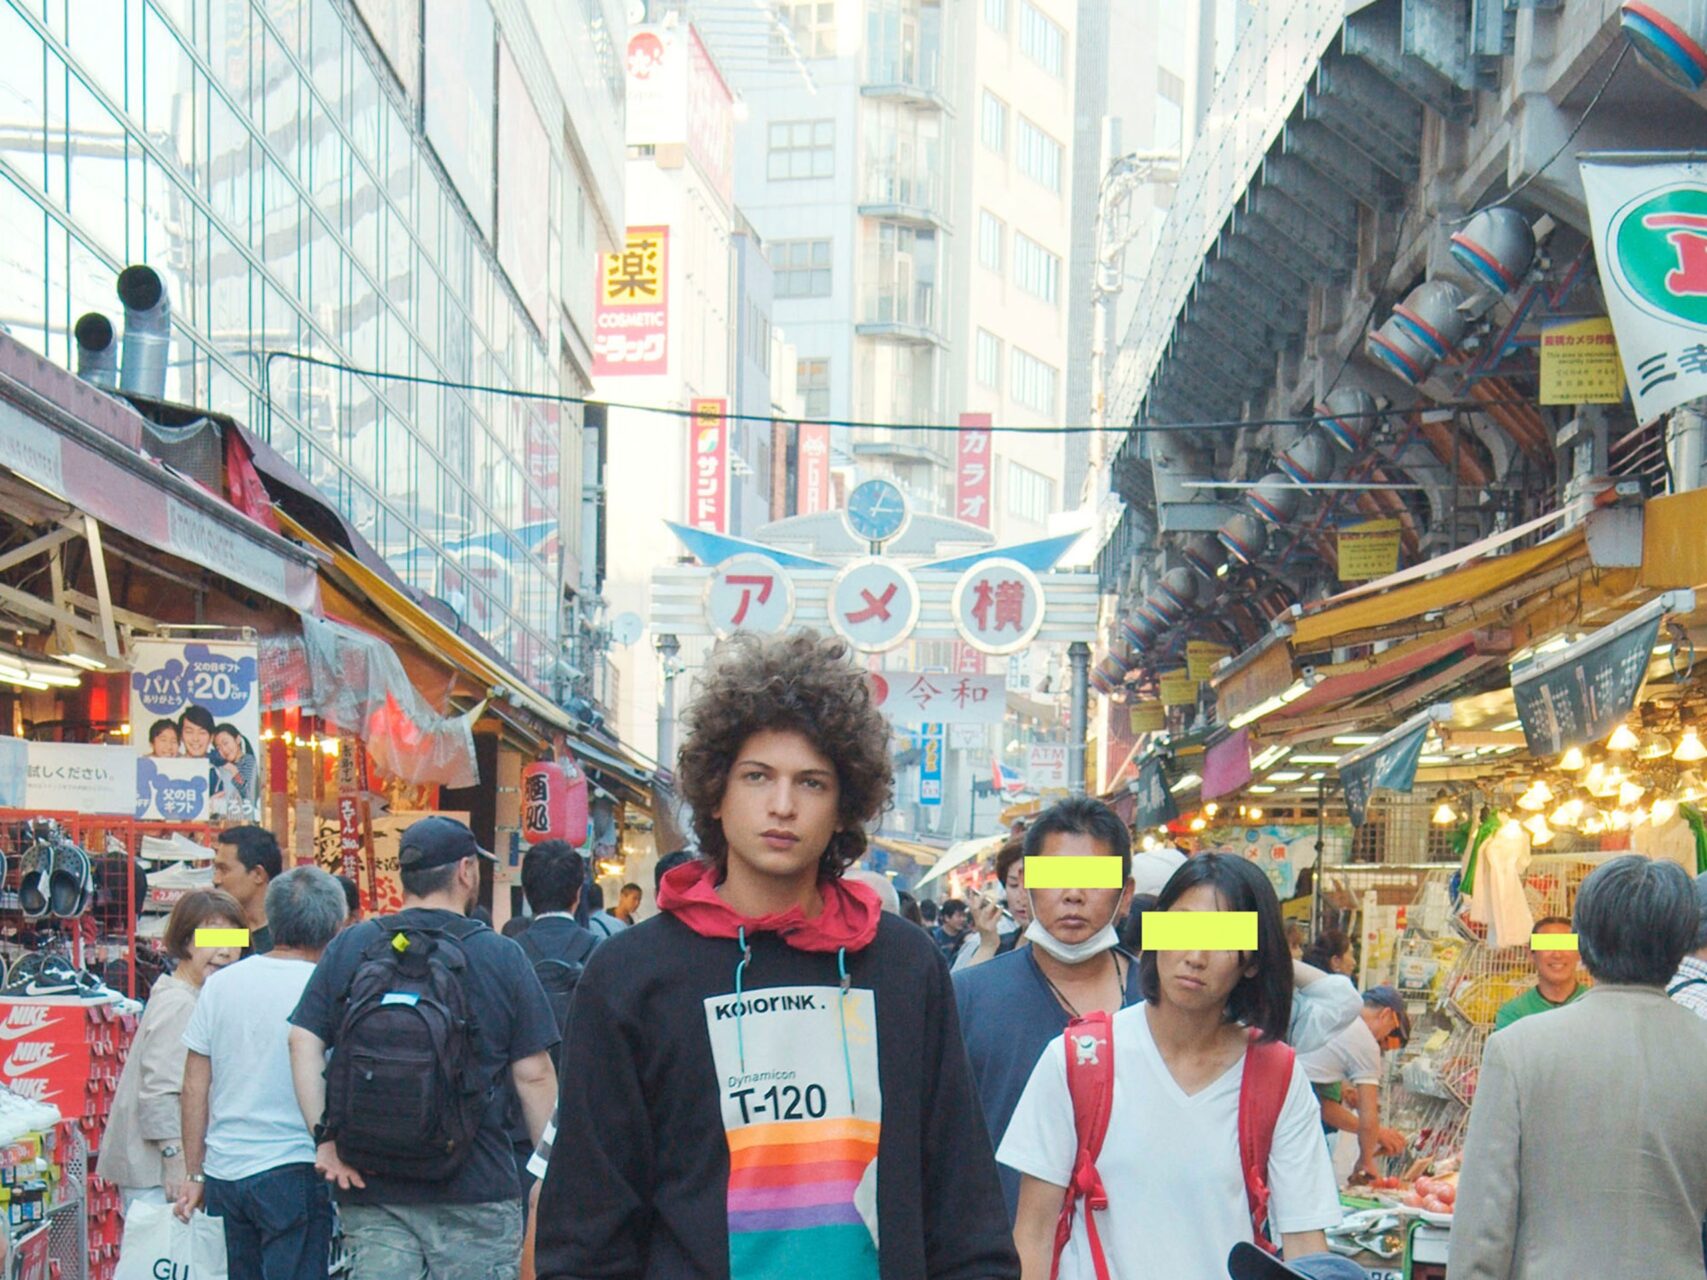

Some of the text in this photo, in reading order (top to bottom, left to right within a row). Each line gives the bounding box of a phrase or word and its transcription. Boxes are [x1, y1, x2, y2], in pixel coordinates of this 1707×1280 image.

[607, 239, 658, 298] 薬
[598, 311, 665, 328] COSMETIC
[960, 430, 988, 518] カラオ
[725, 575, 1025, 632] アメ横
[193, 662, 240, 673] 父の日ギフト
[143, 675, 182, 694] パパ
[906, 676, 988, 710] 令和
[143, 695, 182, 705] ありがとう
[1031, 748, 1064, 759] ATM
[163, 789, 197, 801] 父の日
[164, 802, 195, 814] ギフト
[7, 1006, 50, 1025] NIKE
[15, 1042, 55, 1062] NIKE
[10, 1079, 50, 1097] NIKE
[729, 1069, 796, 1090] Dynamicon
[730, 1084, 827, 1124] T-120
